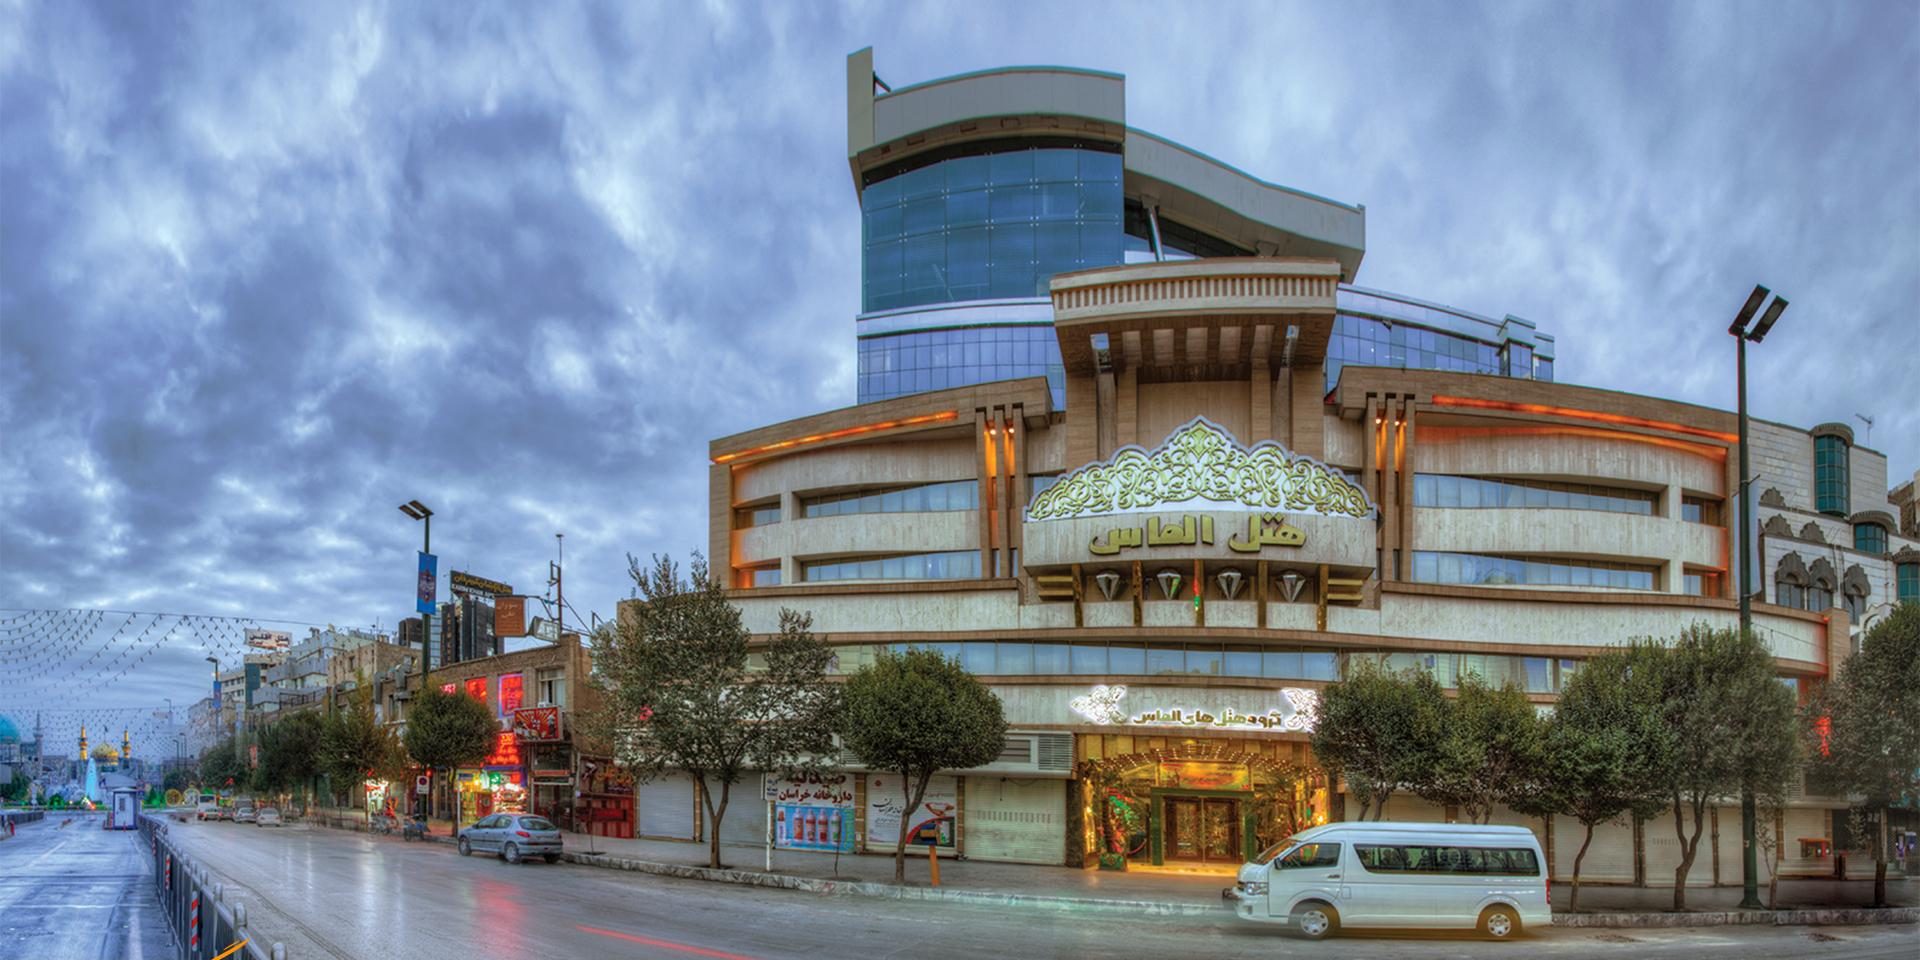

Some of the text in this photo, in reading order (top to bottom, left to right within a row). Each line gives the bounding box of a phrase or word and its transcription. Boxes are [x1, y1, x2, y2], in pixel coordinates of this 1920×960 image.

[1089, 512, 1307, 555] هتل الماس
[1134, 710, 1182, 724] الماس
[1182, 710, 1214, 726] های
[1215, 709, 1247, 726] هتل
[779, 788, 853, 804] داروخانه خراسان
